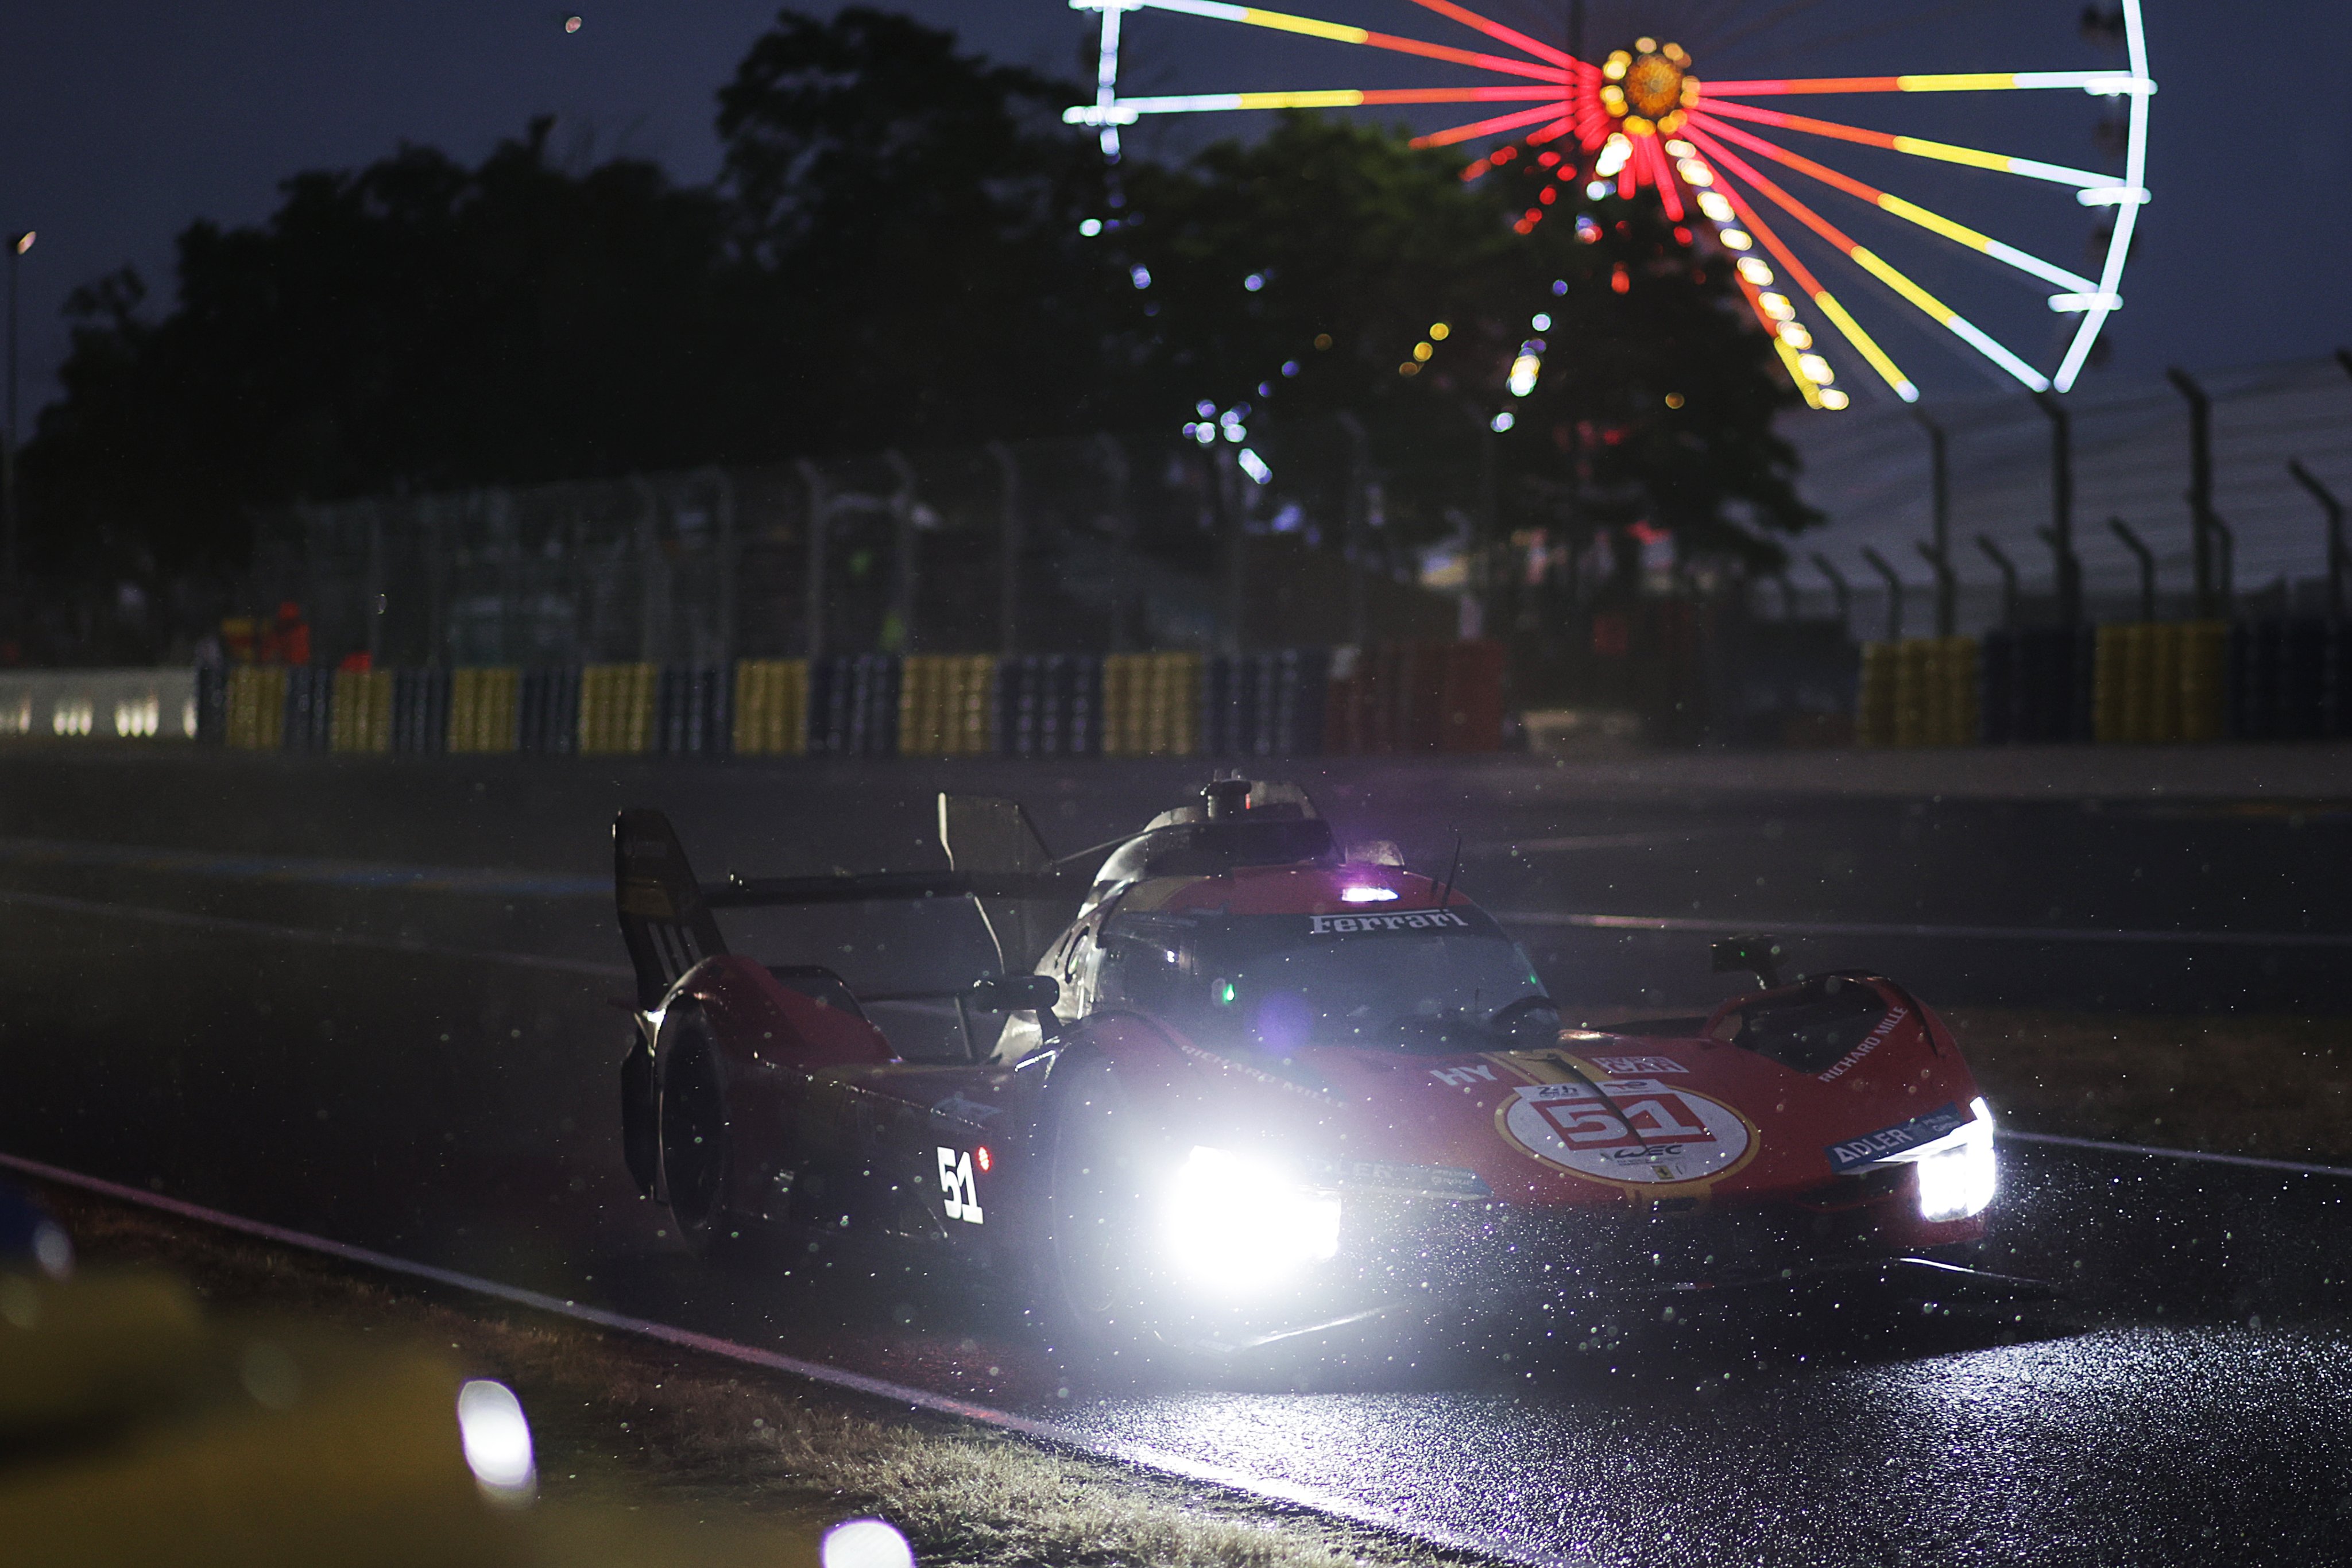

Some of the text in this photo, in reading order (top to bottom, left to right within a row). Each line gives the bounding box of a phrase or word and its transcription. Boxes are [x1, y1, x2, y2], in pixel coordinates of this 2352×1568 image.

[1309, 909, 1469, 934] Ferrari
[1817, 1005, 1909, 1082] RICHARD MILLE
[1181, 1044, 1350, 1111] RICHARD MILLE
[1430, 1064, 1498, 1086] HY
[1545, 1099, 1703, 1143] 51
[1614, 1145, 1683, 1159] WEC
[1832, 1128, 1914, 1164] ADLER
[937, 1146, 984, 1225] 51
